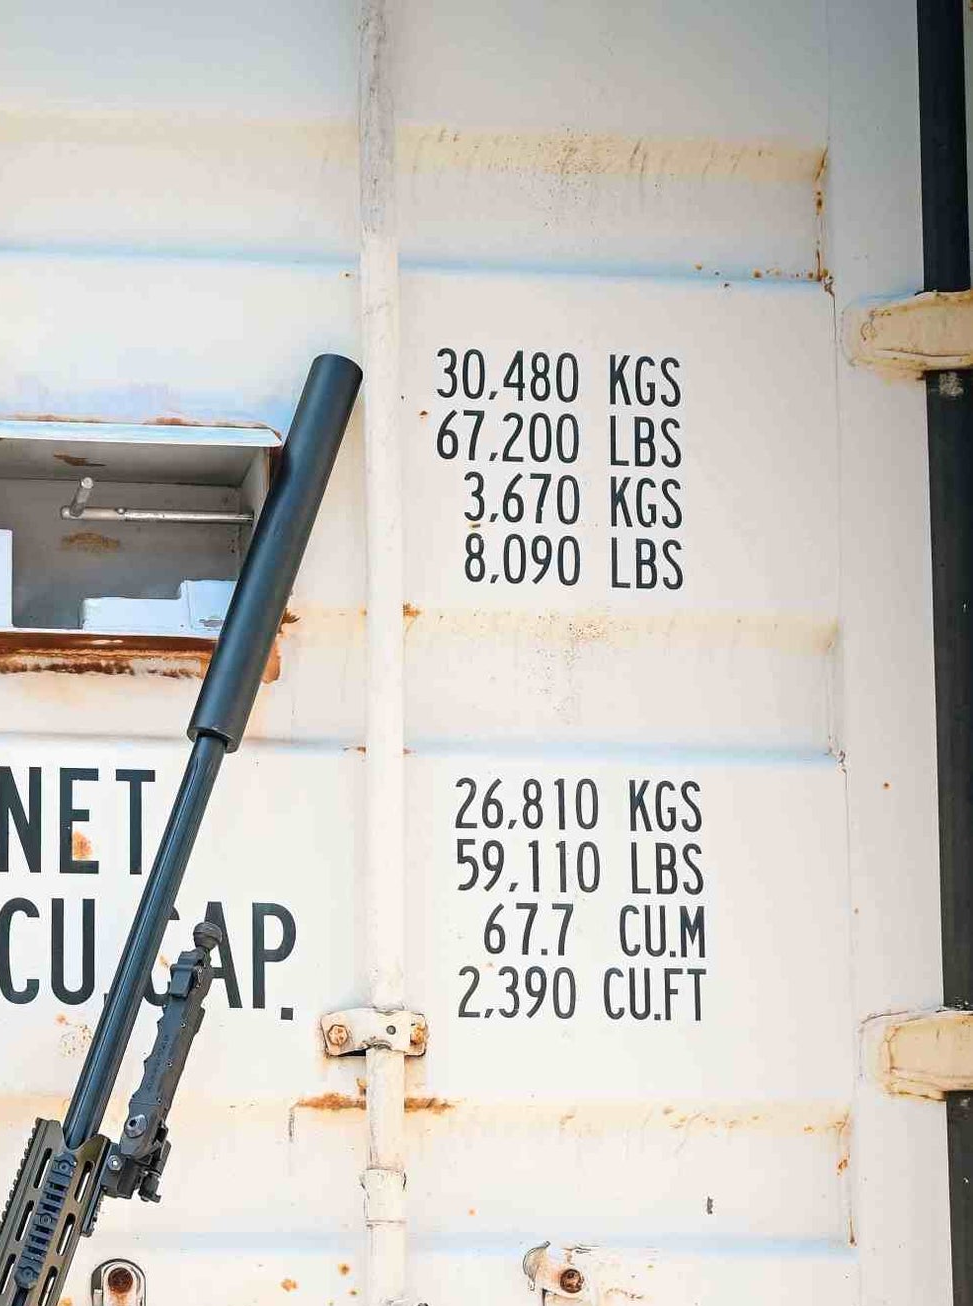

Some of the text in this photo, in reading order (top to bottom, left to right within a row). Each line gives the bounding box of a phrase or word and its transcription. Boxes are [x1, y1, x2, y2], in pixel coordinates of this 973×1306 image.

[436, 347, 682, 408] 30,480 KGS
[436, 409, 683, 469] 67,200 LBS
[463, 471, 684, 529] 3,670 KGS
[463, 532, 685, 590] 8,090 LBS
[455, 777, 703, 833] 26,810 KGS
[456, 838, 705, 896] 59,110 LBS
[483, 902, 707, 959] 67.7 CU.M
[458, 965, 707, 1022] 2,390 CU.FT
